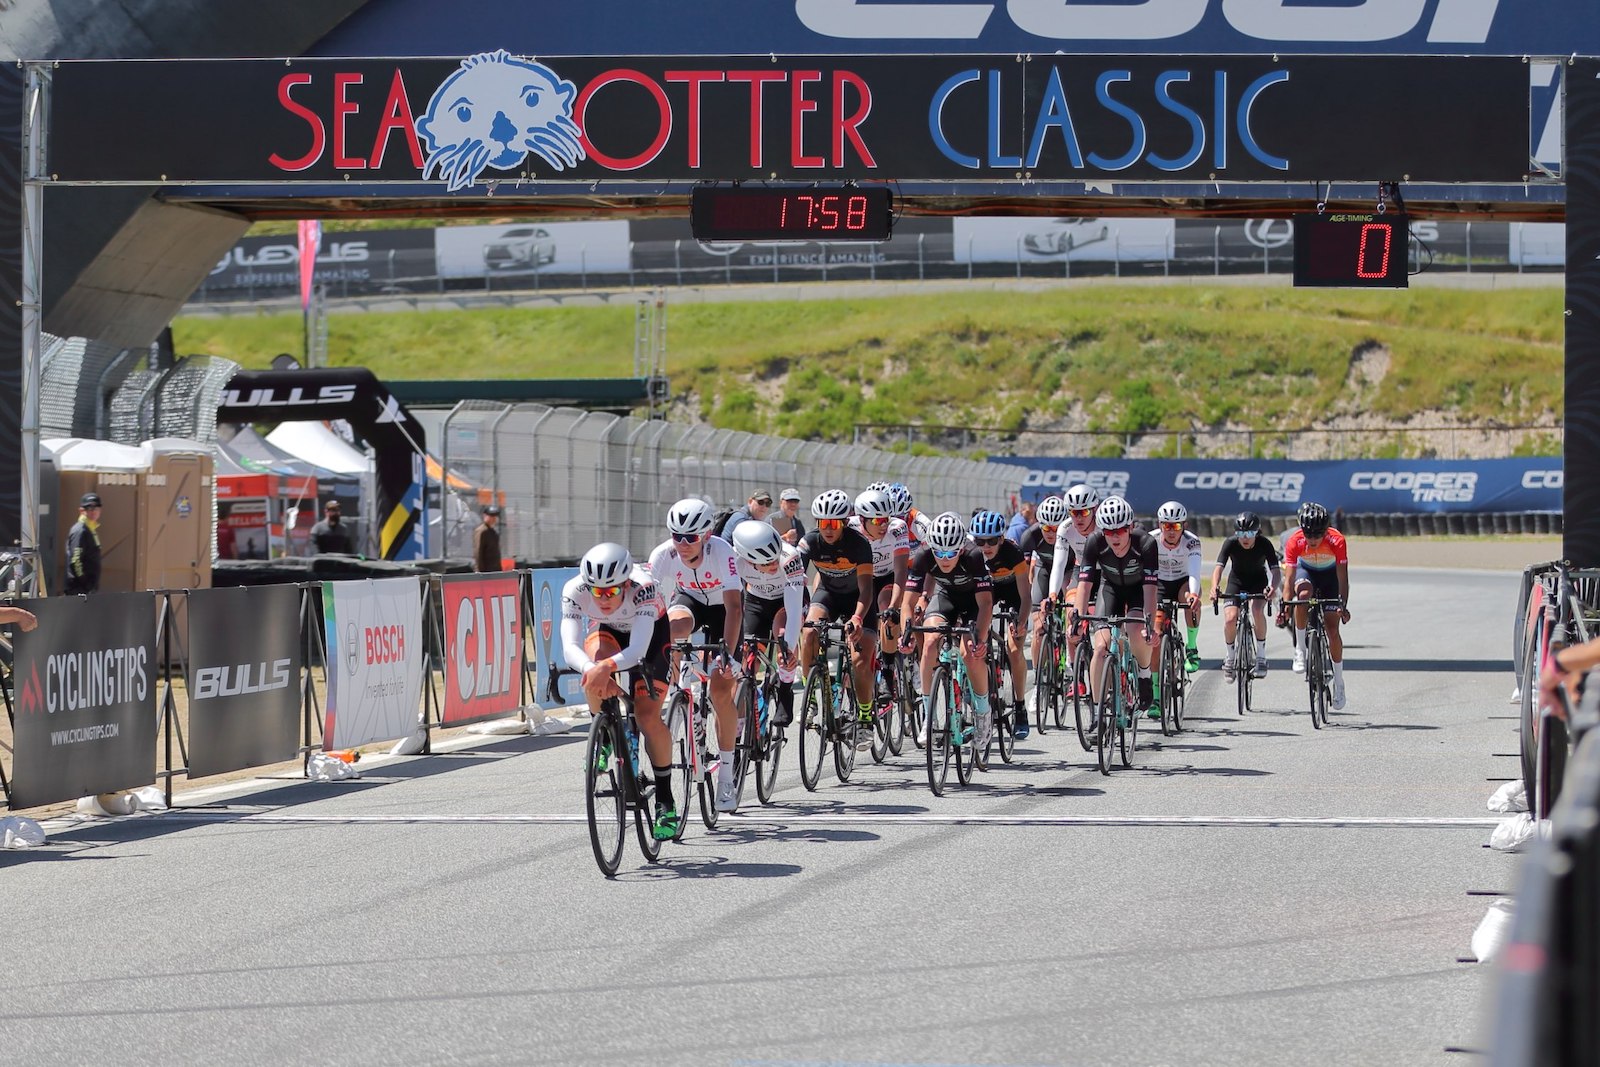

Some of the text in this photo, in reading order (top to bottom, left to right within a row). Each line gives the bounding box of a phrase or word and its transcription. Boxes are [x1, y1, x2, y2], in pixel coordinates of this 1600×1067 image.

[269, 64, 1290, 171] SEA OTTER CLASSIC
[780, 196, 867, 229] 17:58
[749, 252, 886, 265] EXPERIENCE AMAZING
[1357, 223, 1392, 278] 0
[235, 269, 370, 285] EXPERIEN AMAZING
[1022, 469, 1130, 487] OOPER
[1174, 472, 1305, 490] COOPER
[1349, 471, 1478, 490] COOPER
[1236, 488, 1302, 502] TIRES
[1411, 488, 1475, 502] TIRES
[365, 624, 405, 665] BOSCH
[456, 595, 516, 700] CLIF
[46, 645, 147, 714] CYCLINGTIPS
[194, 657, 291, 700] BULLS
[51, 722, 120, 746] WWW.CYCLINGTIPS.COM
